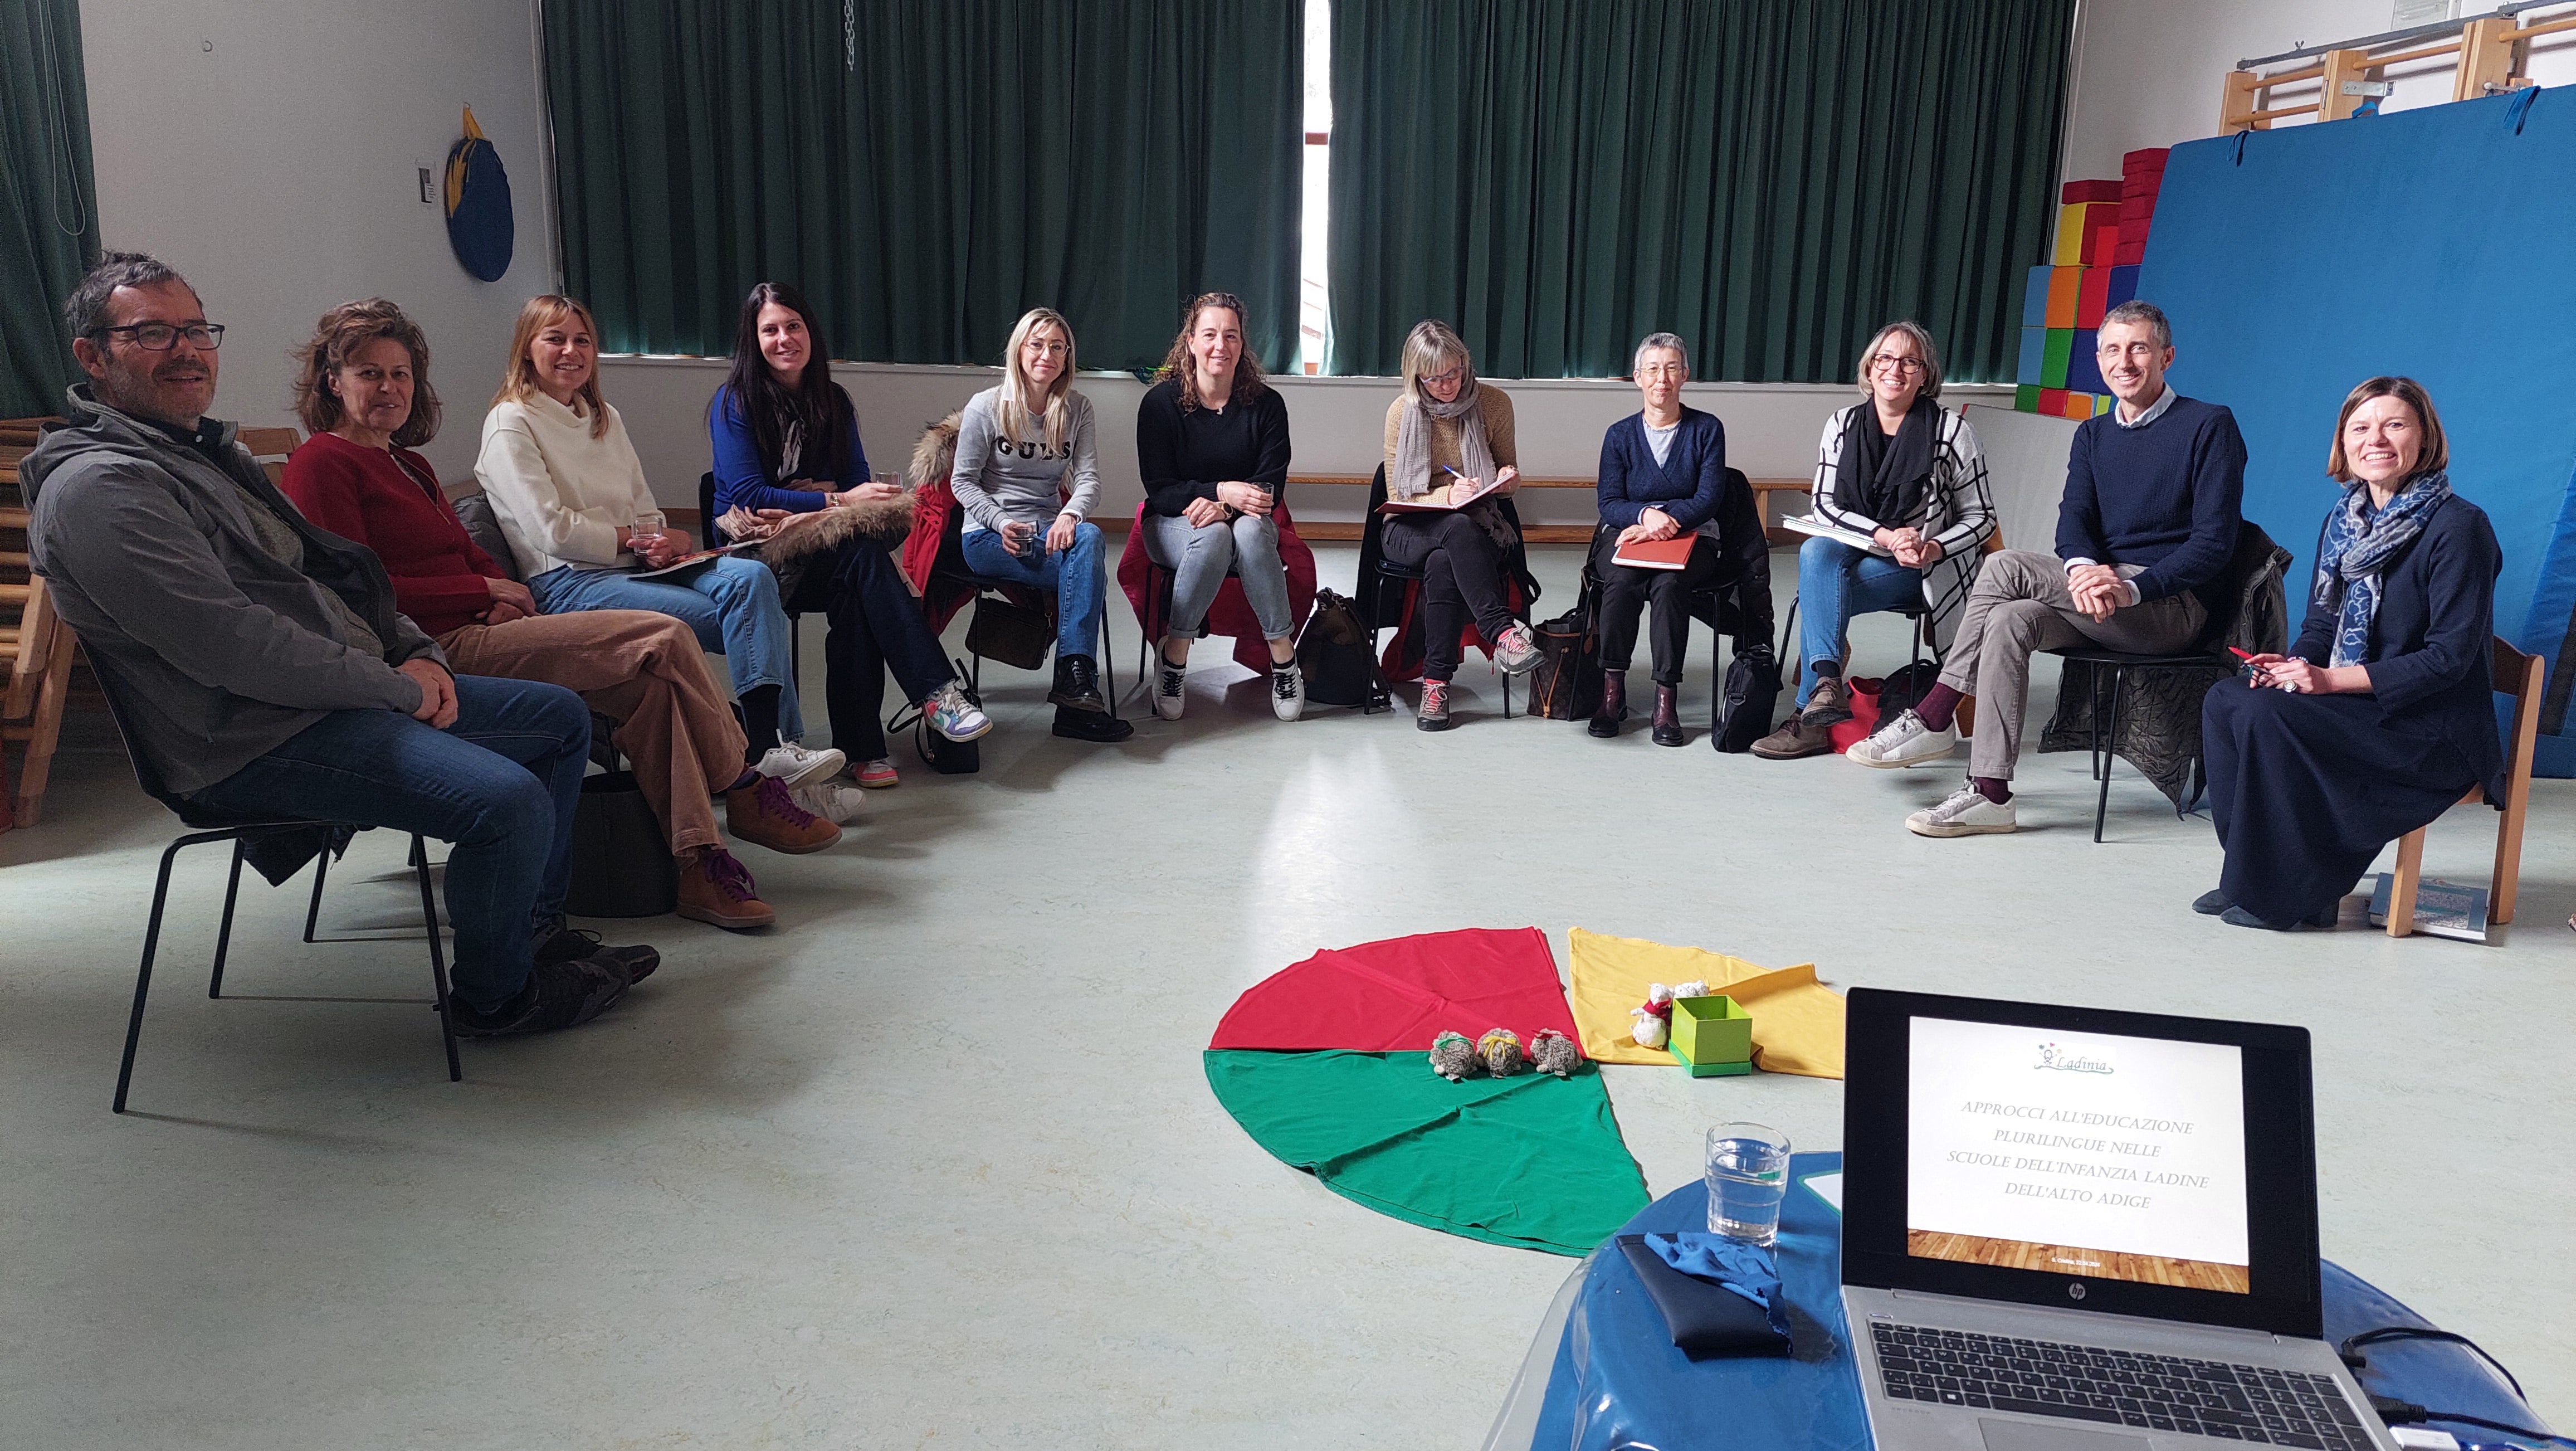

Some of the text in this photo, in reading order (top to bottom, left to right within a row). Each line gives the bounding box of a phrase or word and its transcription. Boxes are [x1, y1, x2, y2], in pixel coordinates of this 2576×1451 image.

[2057, 1056, 2106, 1070] Ladinia
[1960, 1101, 2194, 1134] APPROCCI ALL'EDUCAZIONE
[1993, 1129, 2162, 1157] PLURILINGUE NELLE
[1946, 1150, 2210, 1189] SCUOLE DELL'INFANZIA LADINE
[2004, 1182, 2151, 1209] DELL'ALTO ADIGE
[2071, 1283, 2085, 1299] hp
